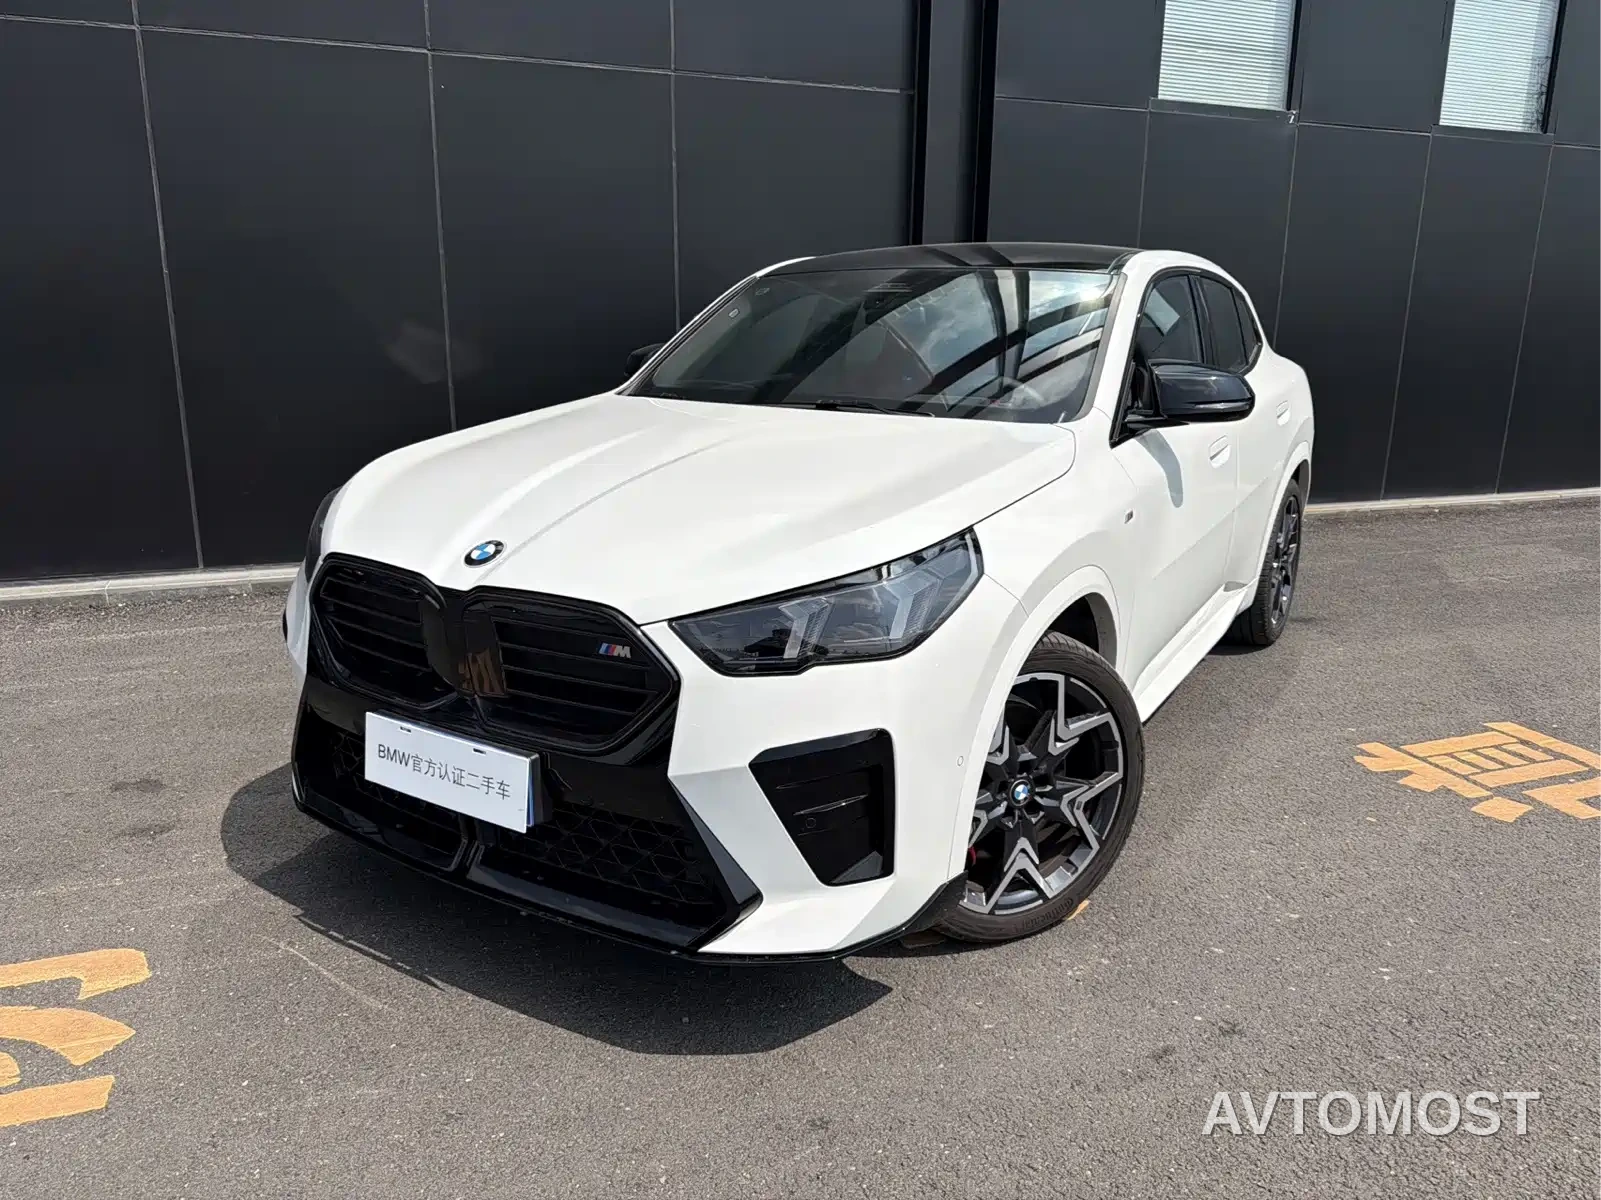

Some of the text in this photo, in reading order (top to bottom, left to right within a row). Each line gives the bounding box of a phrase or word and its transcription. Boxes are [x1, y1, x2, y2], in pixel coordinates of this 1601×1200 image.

[378, 744, 511, 800] BMW官方认证二手车
